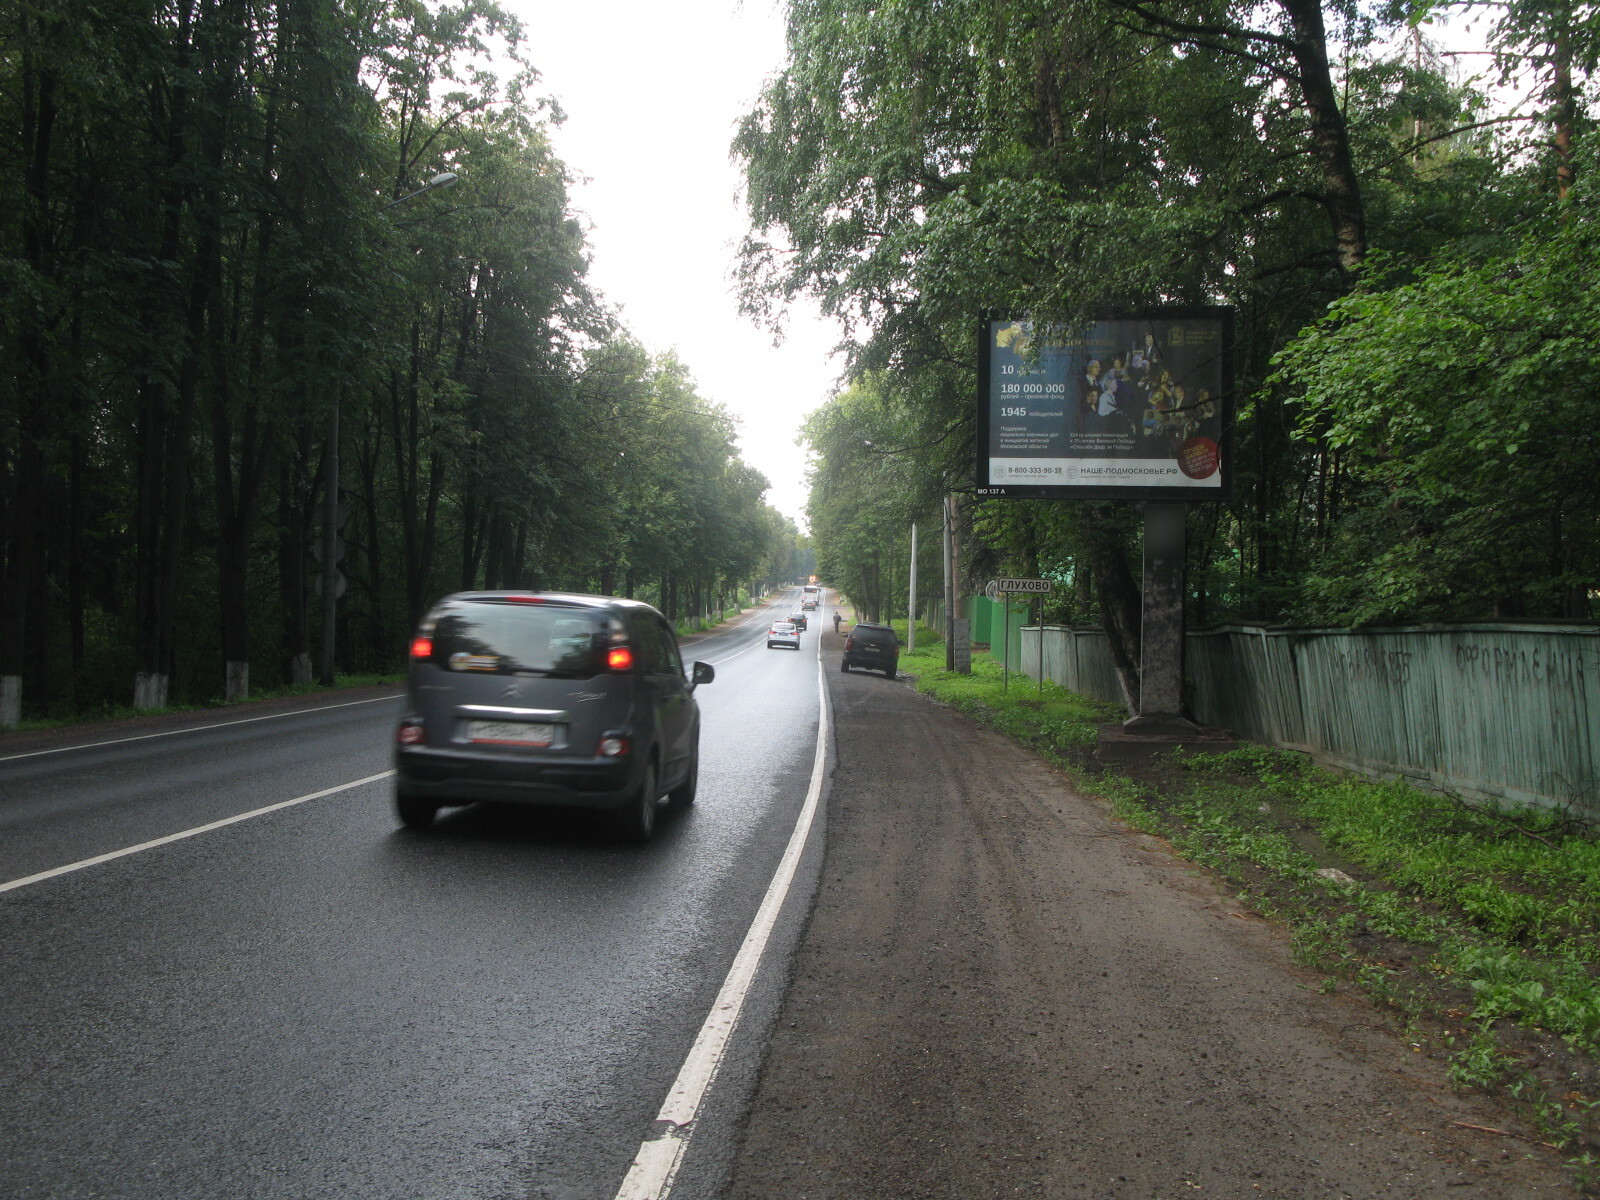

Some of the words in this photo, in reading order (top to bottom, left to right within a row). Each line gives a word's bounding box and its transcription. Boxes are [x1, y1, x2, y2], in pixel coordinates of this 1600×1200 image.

[1002, 365, 1014, 374] 10
[1001, 384, 1020, 393] 180
[1023, 384, 1042, 393] 000
[1046, 384, 1065, 393] 000
[1001, 408, 1026, 416] 1945
[1001, 581, 1048, 590] ГЛУХОВО
